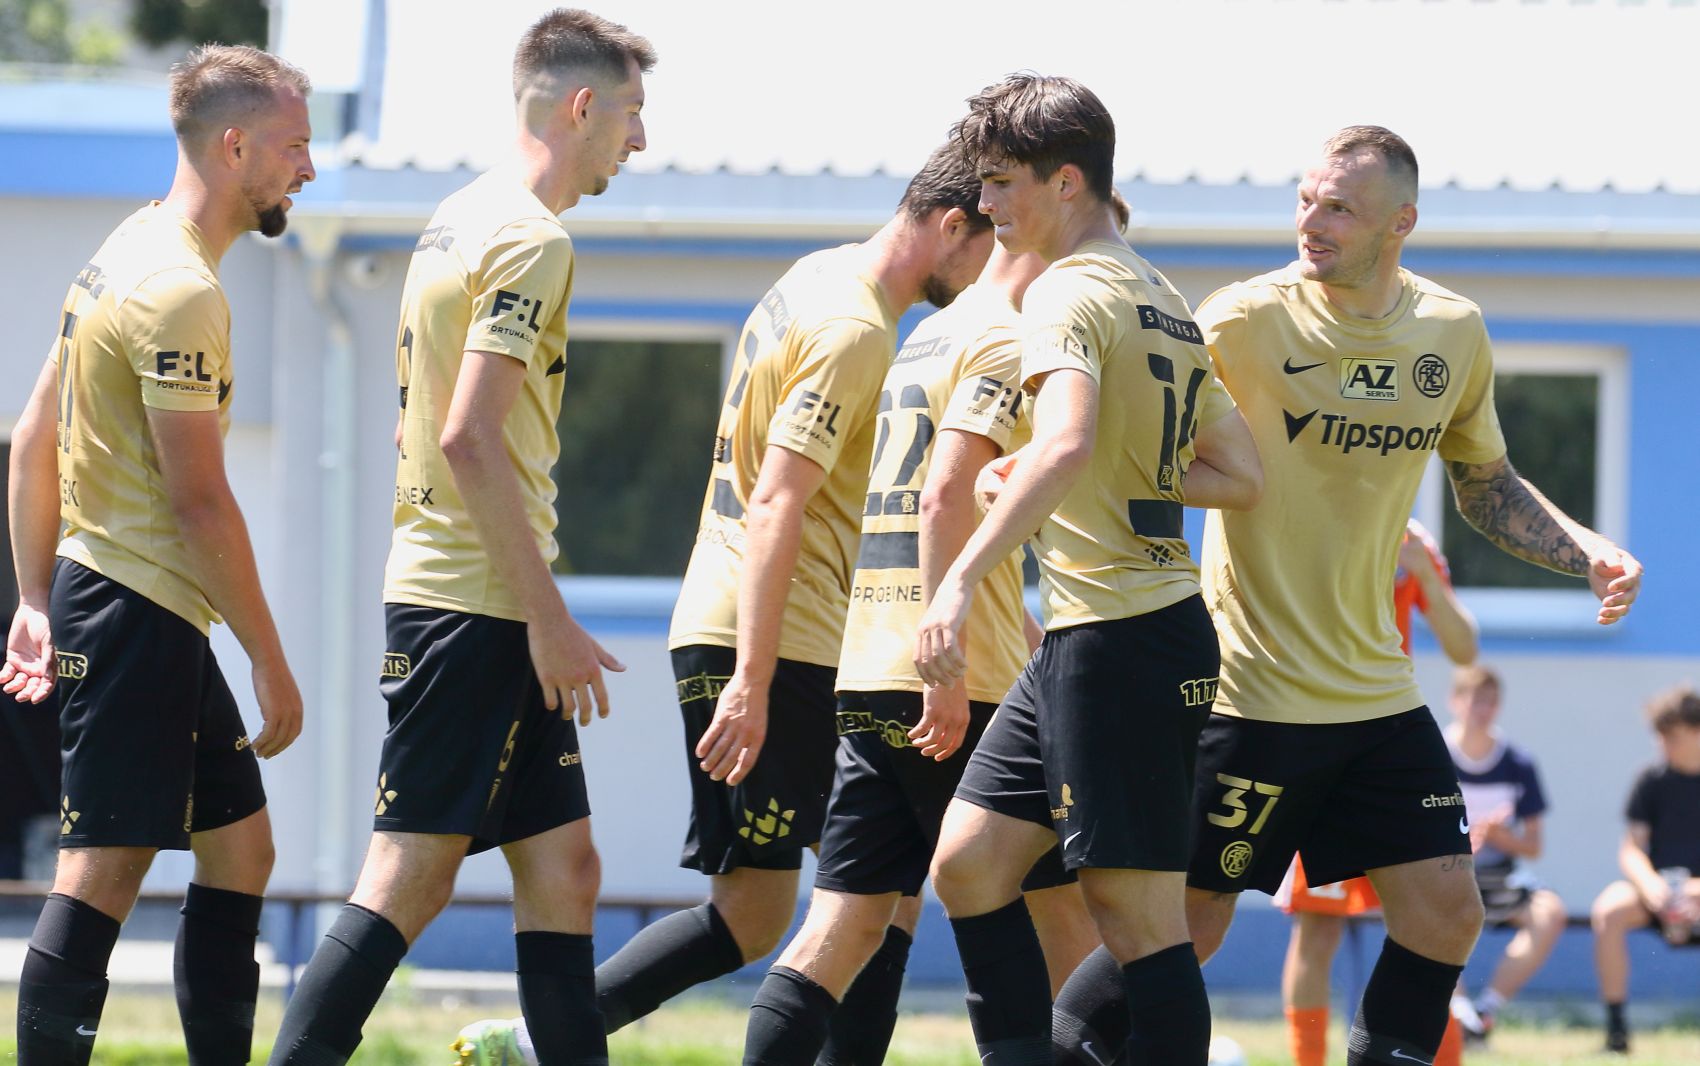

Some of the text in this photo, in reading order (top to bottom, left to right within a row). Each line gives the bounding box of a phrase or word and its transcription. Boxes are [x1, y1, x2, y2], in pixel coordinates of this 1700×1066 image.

[491, 289, 543, 334] F:L
[156, 351, 212, 382] F:L
[1348, 364, 1395, 390] AZ
[1320, 414, 1442, 457] Tipsport
[1207, 772, 1284, 835] 37
